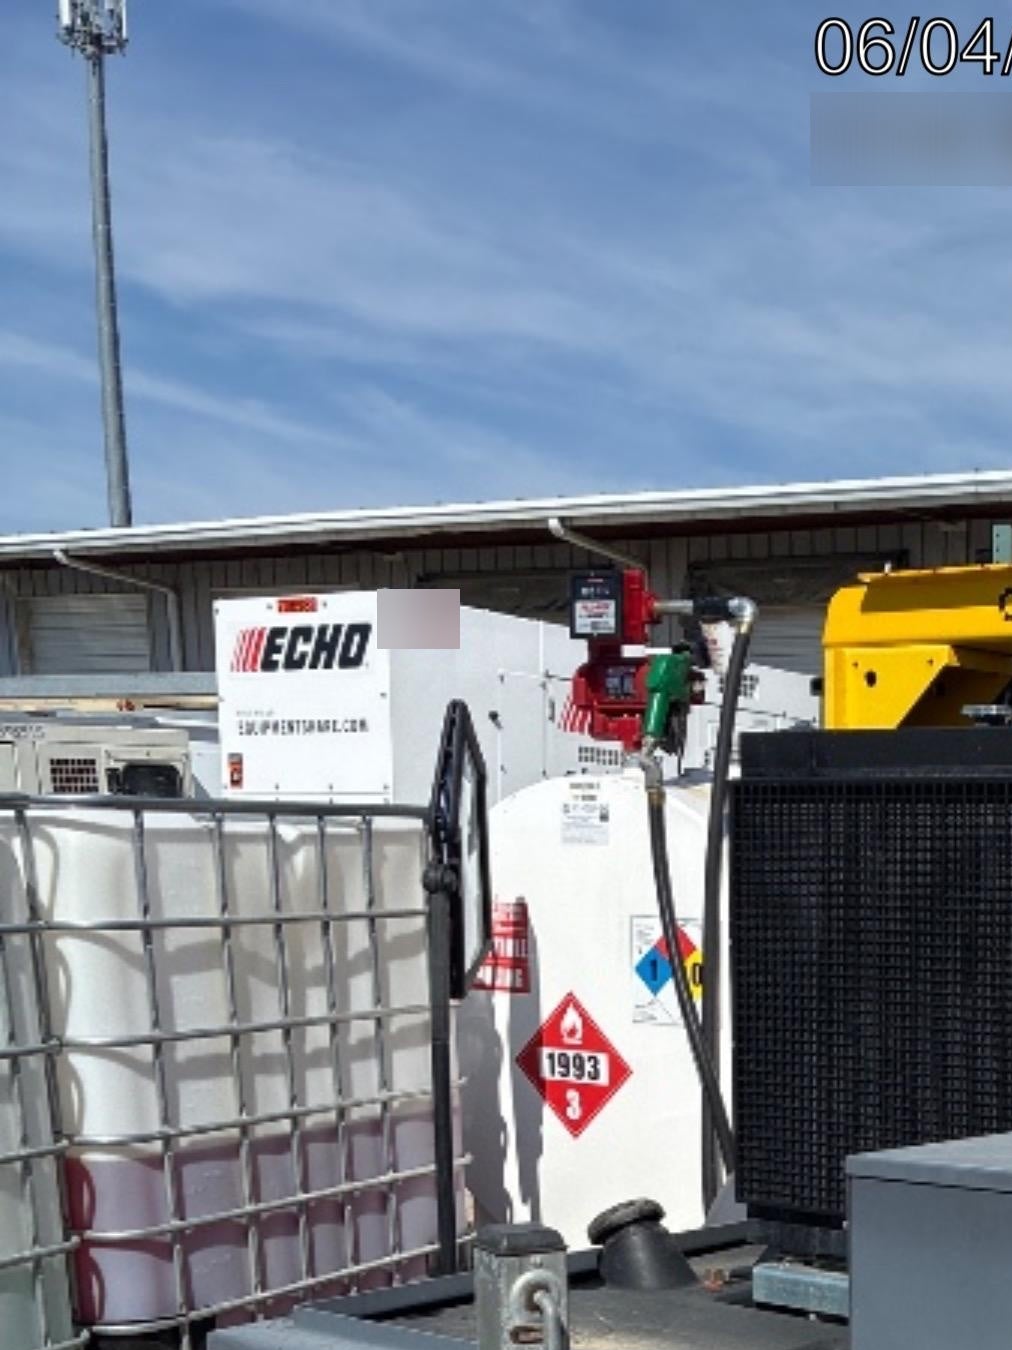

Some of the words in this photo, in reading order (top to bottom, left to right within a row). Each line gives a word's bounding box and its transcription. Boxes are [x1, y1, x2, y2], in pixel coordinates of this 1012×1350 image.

[260, 623, 372, 672] ECHO
[649, 958, 659, 982] 1
[546, 1052, 601, 1081] 1993
[565, 1088, 583, 1120] 3
